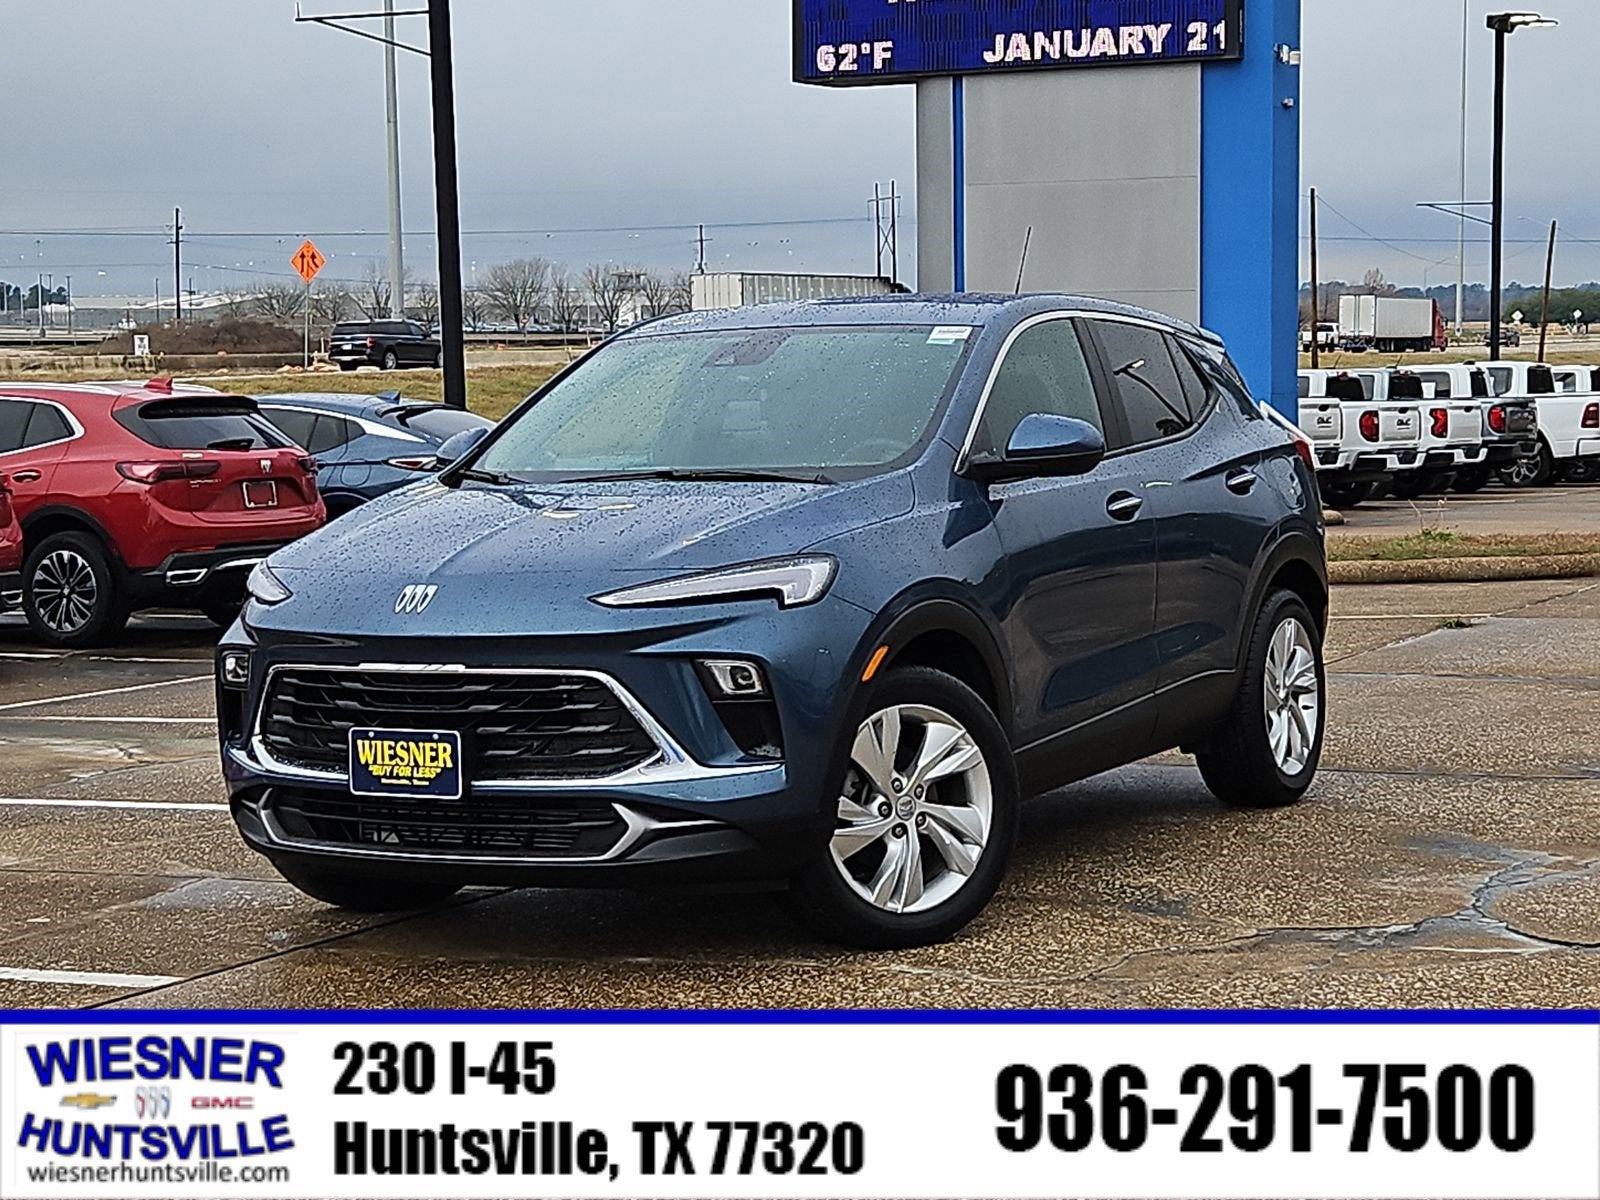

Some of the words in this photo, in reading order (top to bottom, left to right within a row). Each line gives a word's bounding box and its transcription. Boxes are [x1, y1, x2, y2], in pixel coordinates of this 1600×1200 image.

[816, 41, 893, 72] 62°F
[983, 23, 1172, 63] JANUARY
[1187, 20, 1226, 51] 21
[356, 739, 453, 768] WIESNER
[393, 766, 411, 777] FOR
